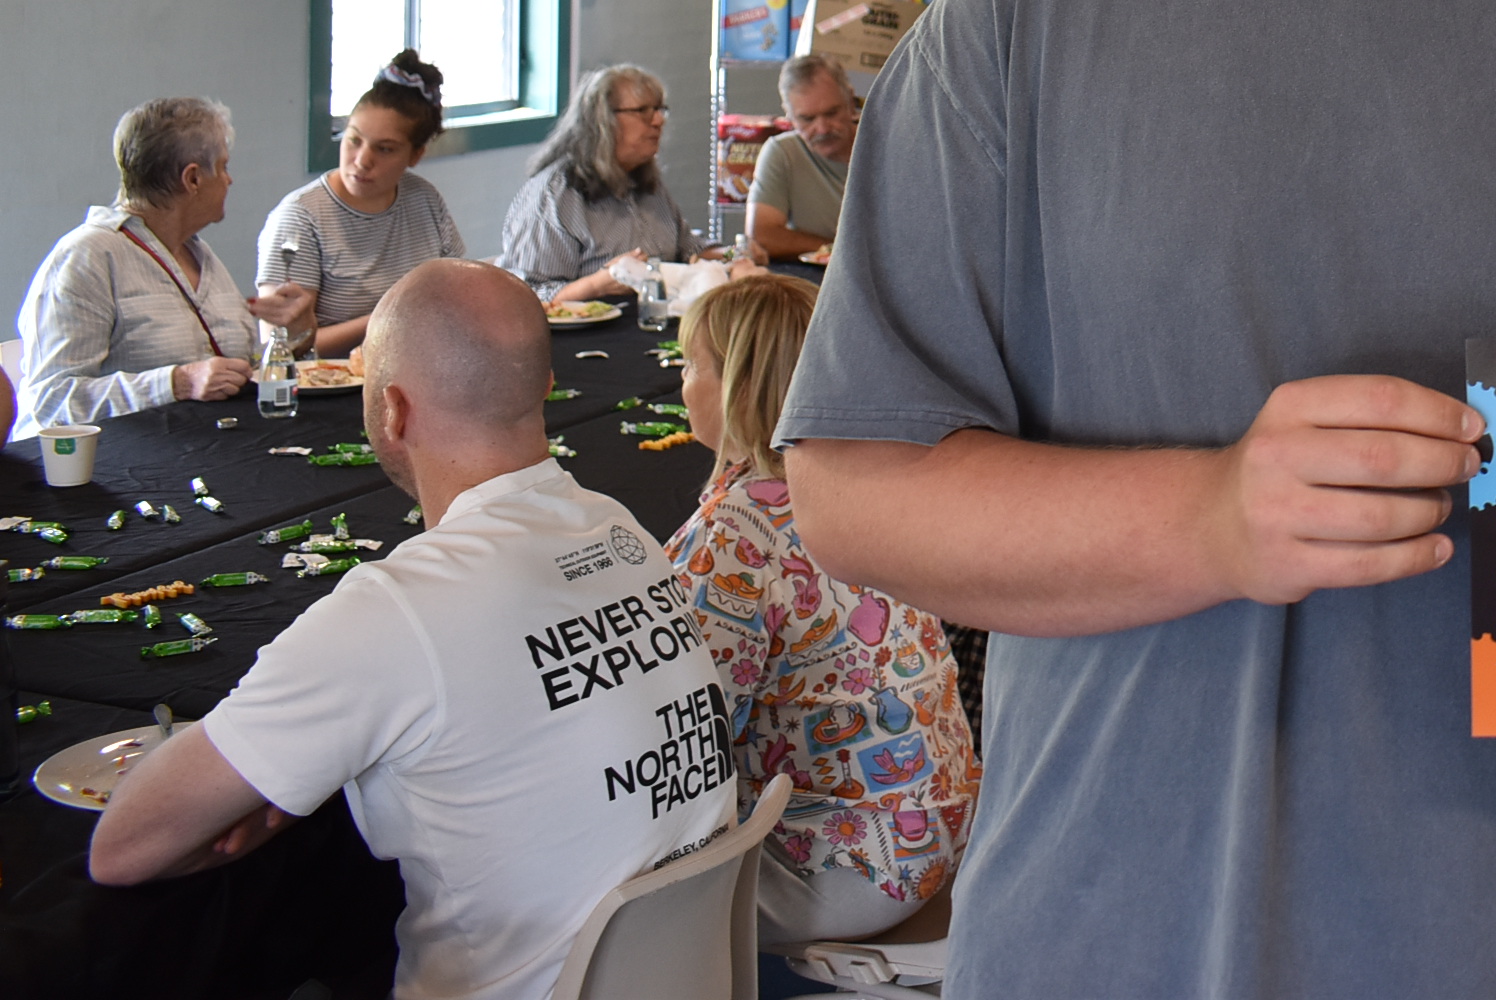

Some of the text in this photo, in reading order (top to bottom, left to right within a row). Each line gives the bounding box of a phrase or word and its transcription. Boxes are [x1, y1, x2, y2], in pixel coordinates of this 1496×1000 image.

[563, 564, 594, 581] SINCE
[593, 556, 613, 571] 1966
[525, 574, 691, 669] NEVER STO
[655, 688, 711, 739] THE
[604, 721, 716, 802] NORTH
[651, 755, 718, 819] FACE
